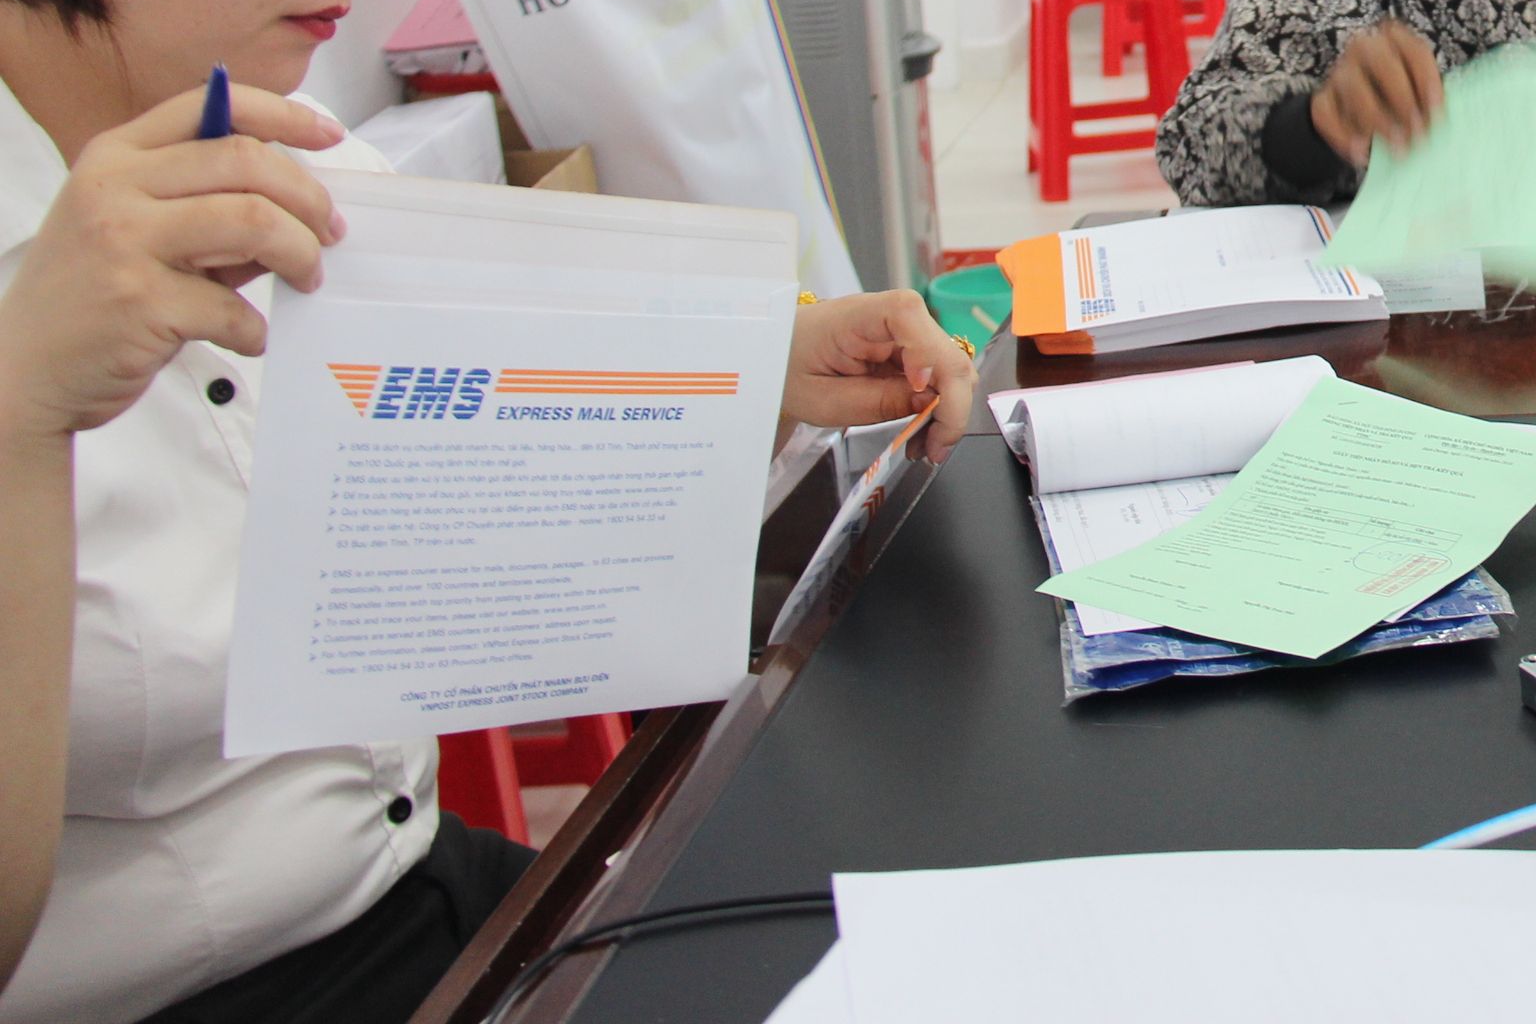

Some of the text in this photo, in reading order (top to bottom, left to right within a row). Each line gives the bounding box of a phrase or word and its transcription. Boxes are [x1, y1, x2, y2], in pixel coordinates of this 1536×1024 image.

[372, 366, 492, 419] EMS
[496, 406, 685, 421] EXPRESS MAIL SERVICE
[421, 687, 588, 711] VNPOST EXPRESS JOINT STOCK COMPANY
